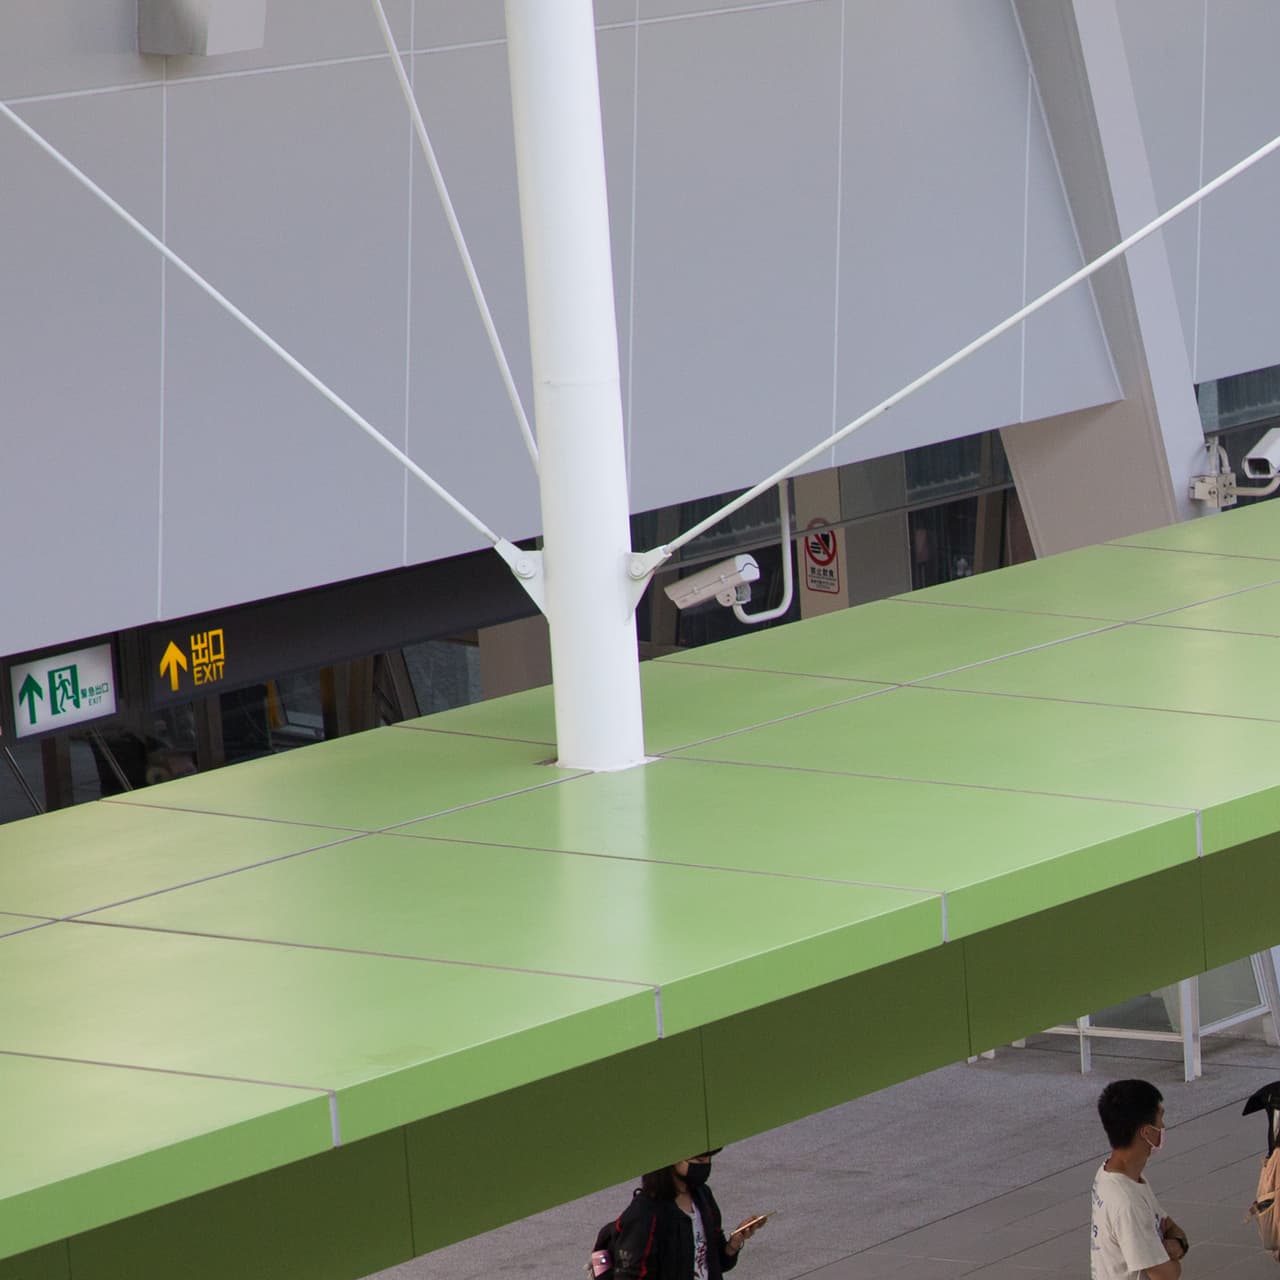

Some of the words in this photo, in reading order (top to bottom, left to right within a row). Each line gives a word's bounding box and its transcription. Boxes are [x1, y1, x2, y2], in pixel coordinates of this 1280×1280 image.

[190, 628, 225, 666] 出口
[193, 662, 224, 686] EXIT
[88, 695, 102, 706] EXIT
